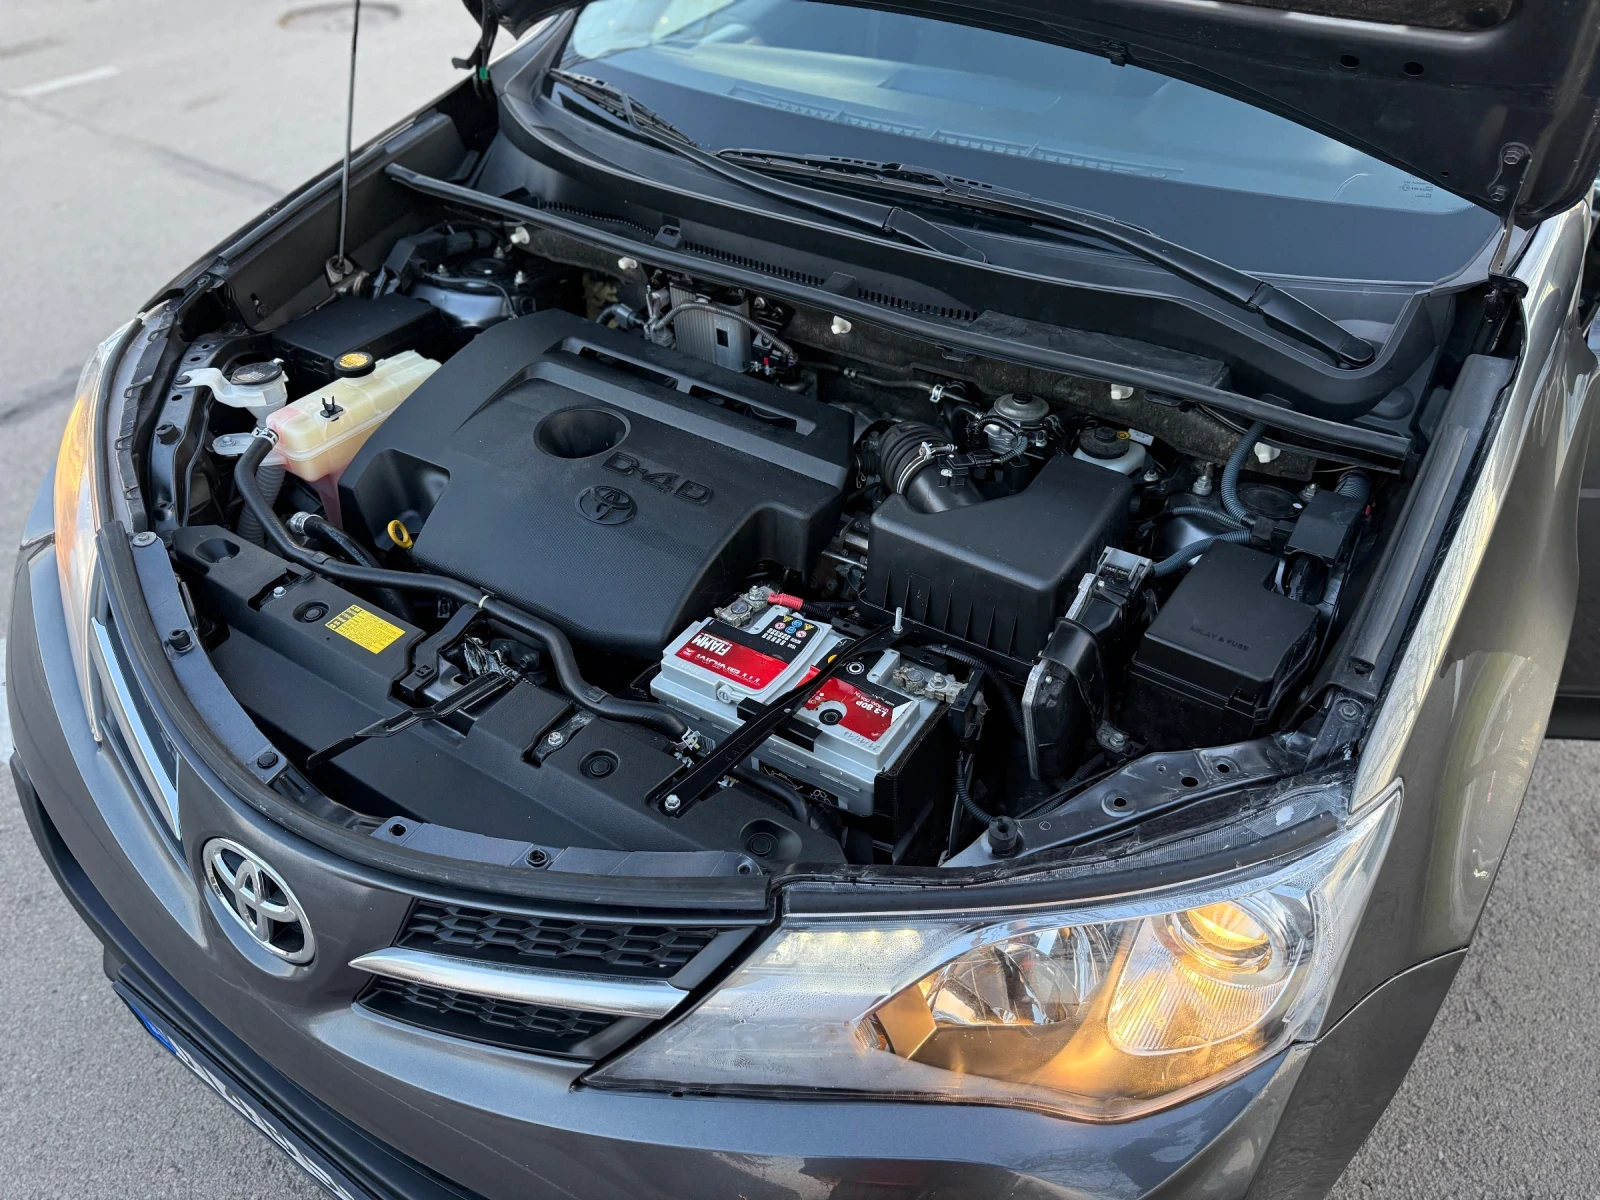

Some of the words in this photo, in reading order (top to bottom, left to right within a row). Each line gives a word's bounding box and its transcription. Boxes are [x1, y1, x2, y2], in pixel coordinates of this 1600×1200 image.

[691, 634, 731, 656] FIAMM
[1226, 639, 1249, 652] FUSE
[695, 653, 760, 686] TITANIUM
[855, 700, 873, 711] 80P
[874, 707, 887, 717] L3
